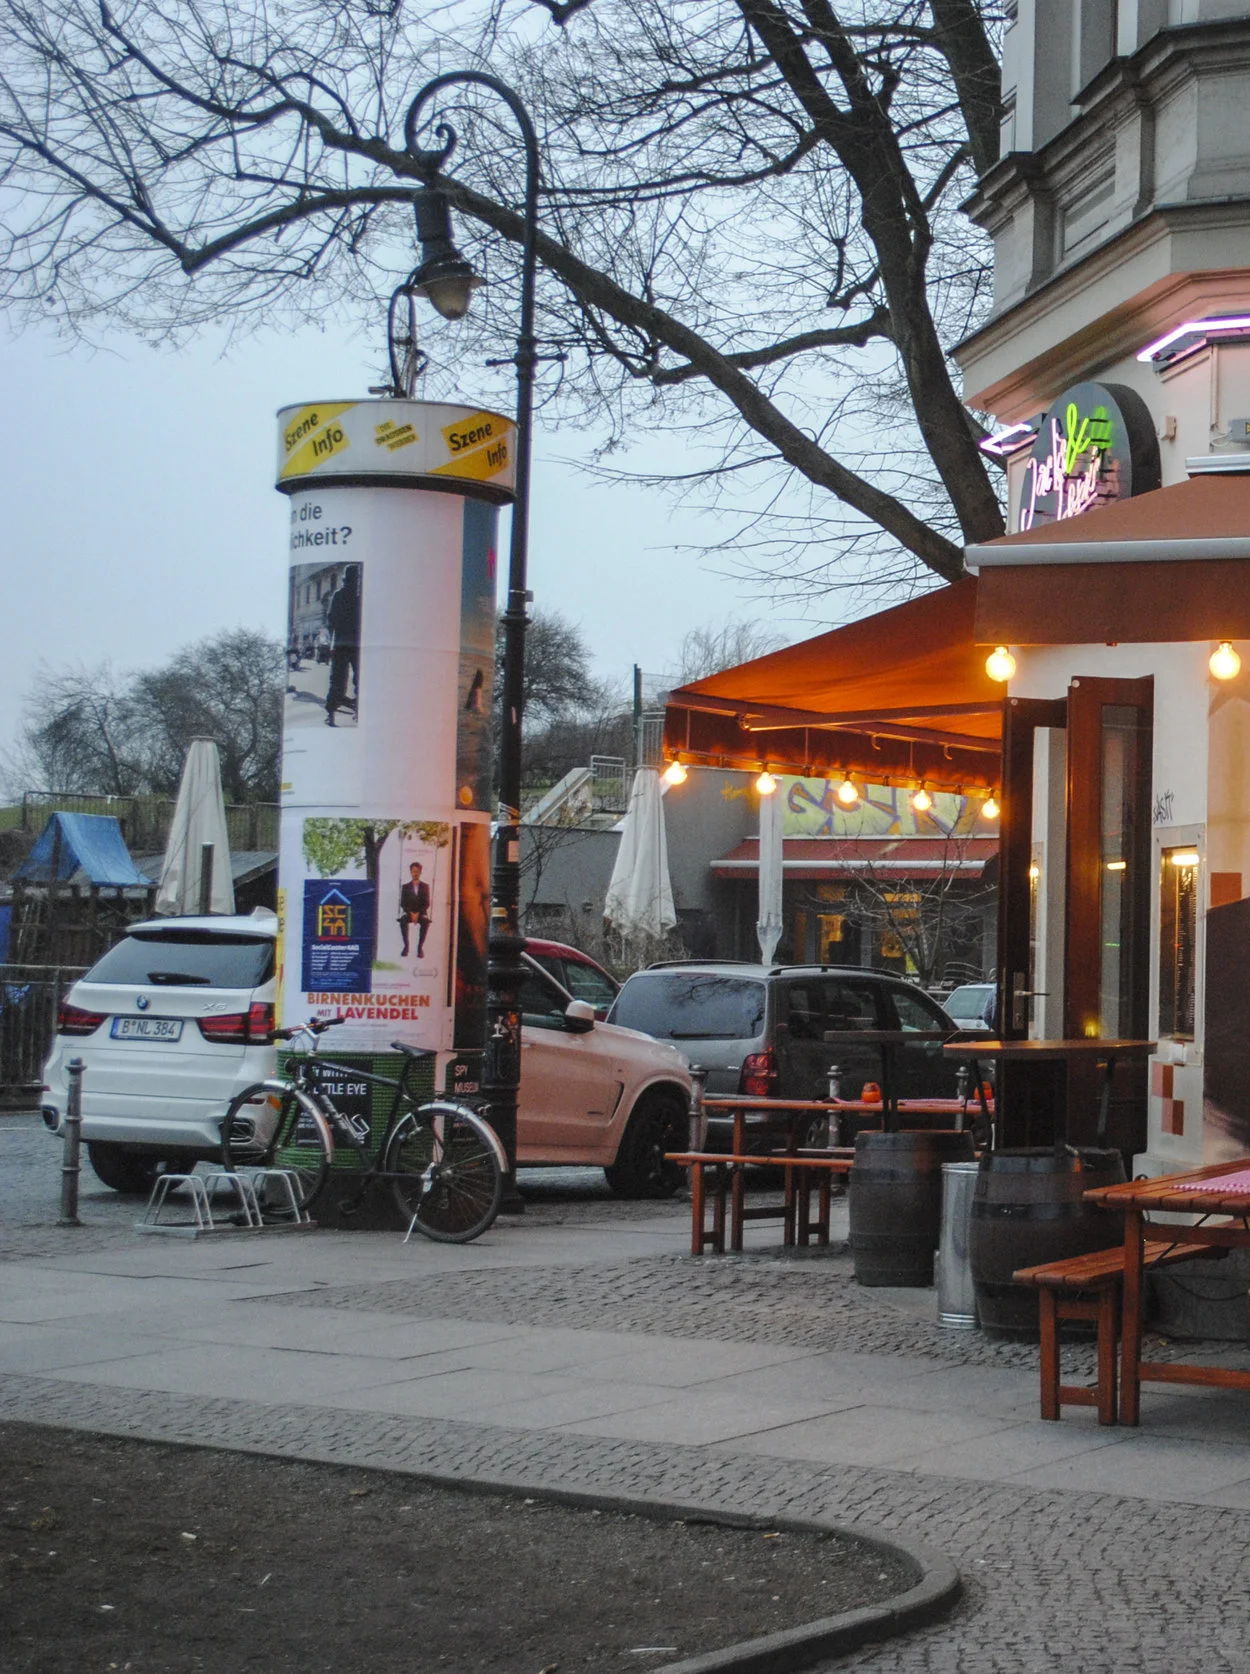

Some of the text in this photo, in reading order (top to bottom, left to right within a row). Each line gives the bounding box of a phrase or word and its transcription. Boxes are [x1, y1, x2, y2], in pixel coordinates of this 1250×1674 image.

[285, 413, 319, 452] Szene
[449, 423, 492, 451] Szene
[313, 428, 343, 456] Info
[487, 443, 507, 467] Info
[300, 502, 322, 521] die
[307, 992, 431, 1007] BIRNENKUCHEN
[317, 1006, 419, 1020] MIT LAVENDEL
[136, 1020, 151, 1035] NL
[153, 1021, 176, 1036] 384
[455, 1065, 468, 1077] SPY
[313, 1083, 367, 1095] LTLE EYE
